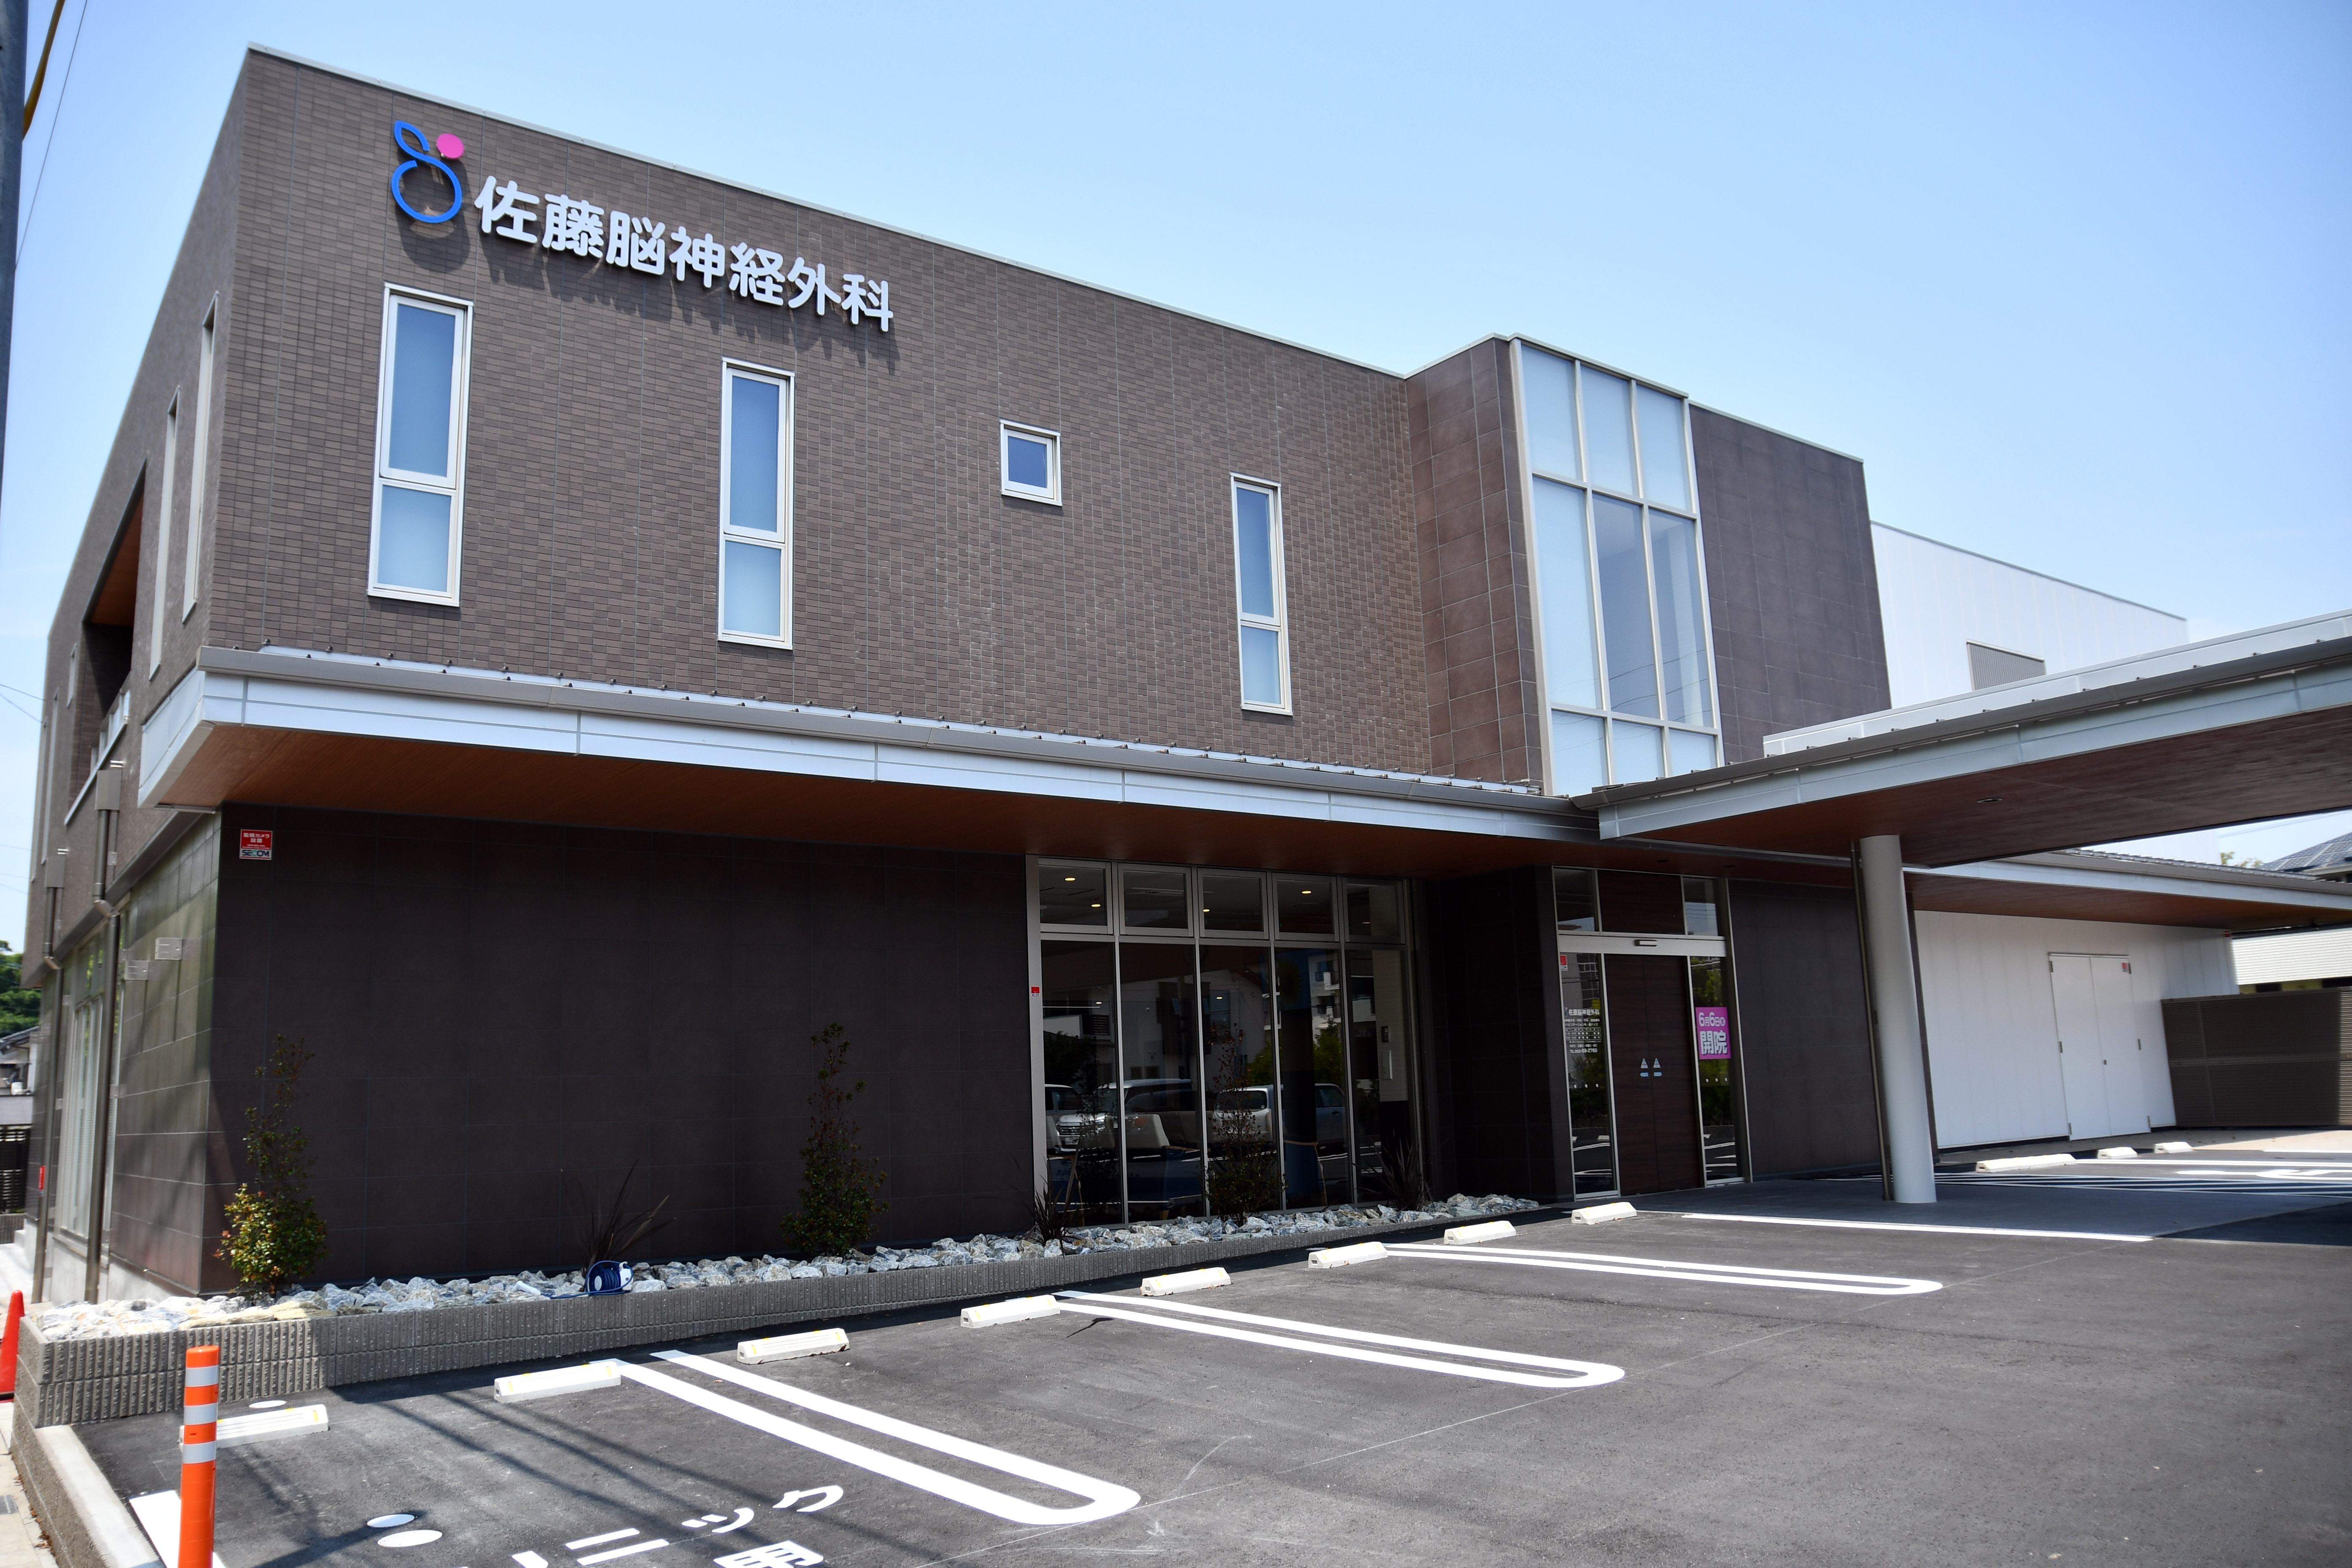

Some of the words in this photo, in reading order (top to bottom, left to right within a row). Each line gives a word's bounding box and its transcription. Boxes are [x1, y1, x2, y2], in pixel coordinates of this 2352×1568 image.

[475, 175, 893, 333] 佐藤脳神経外科
[1700, 1030, 1728, 1055] 開院
